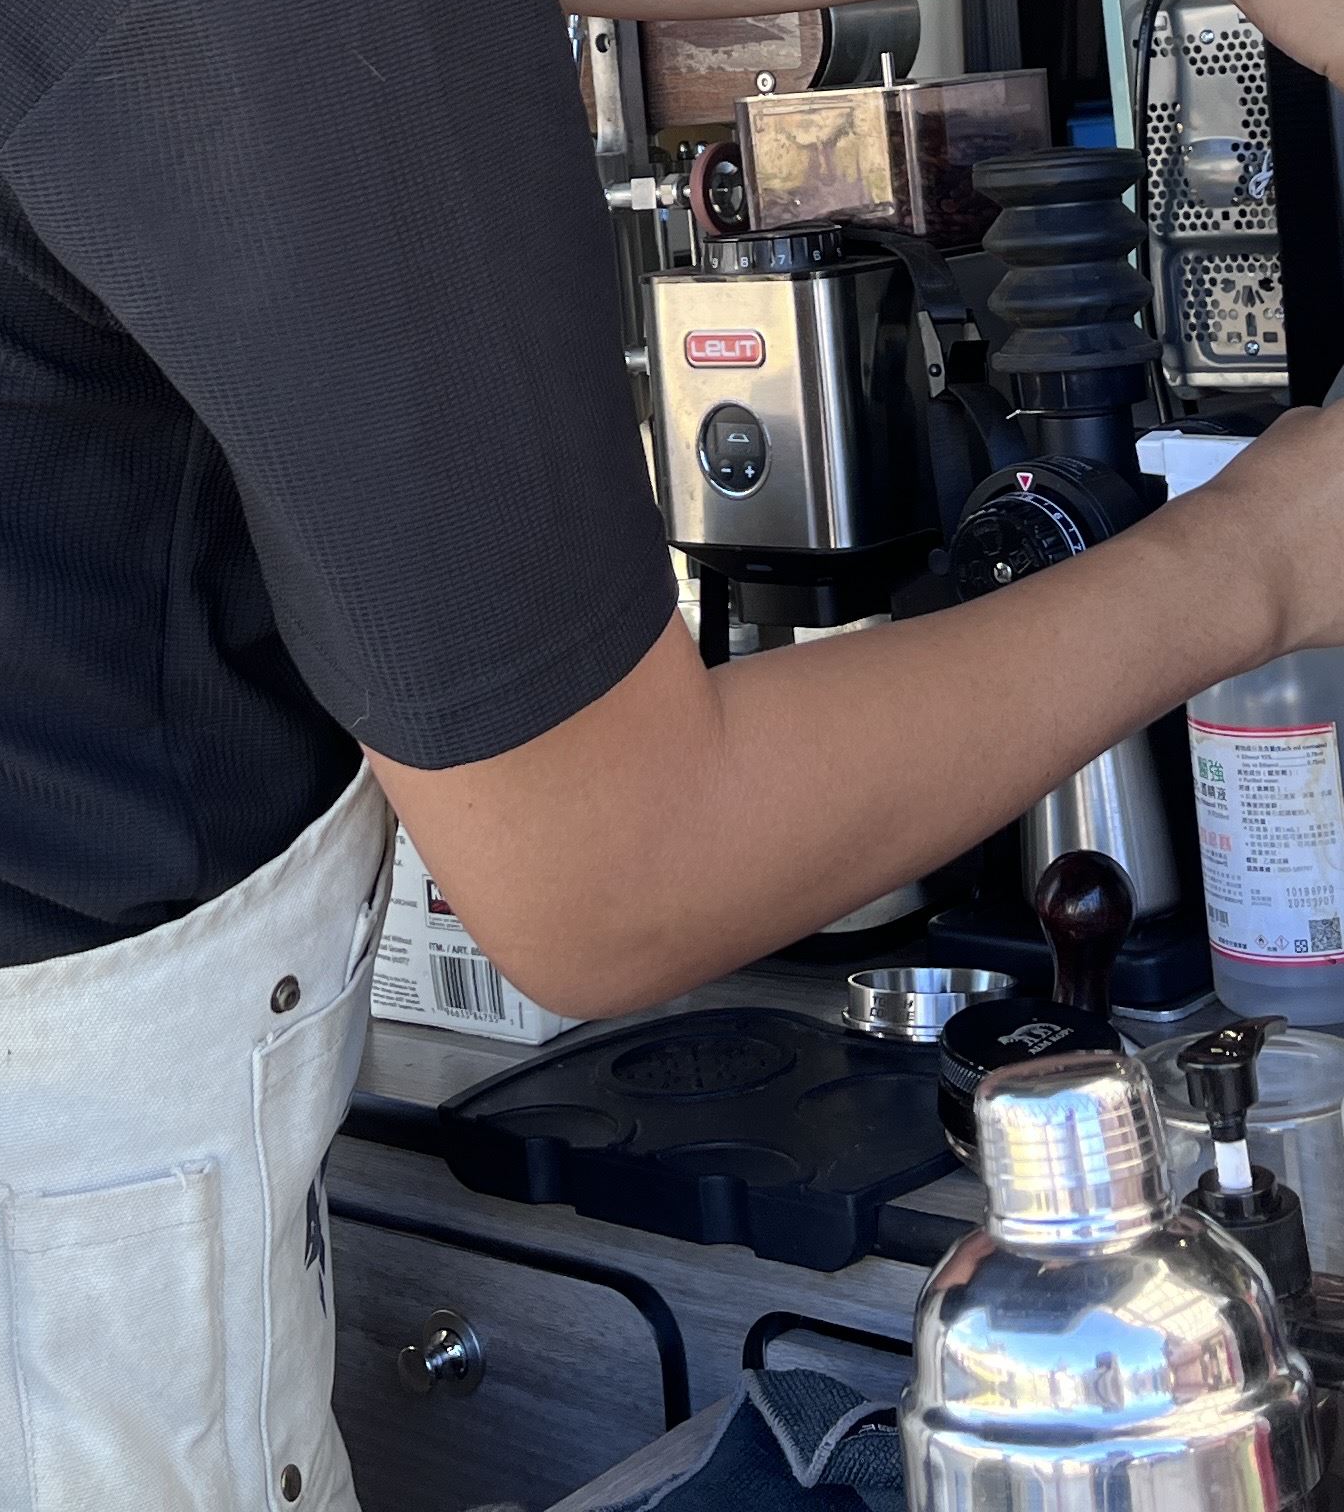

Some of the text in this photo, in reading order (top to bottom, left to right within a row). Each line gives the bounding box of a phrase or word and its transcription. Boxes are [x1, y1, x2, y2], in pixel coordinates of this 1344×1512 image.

[712, 258, 719, 269] 9
[740, 257, 749, 267] 8
[777, 255, 785, 264] 7
[813, 250, 821, 260] 6
